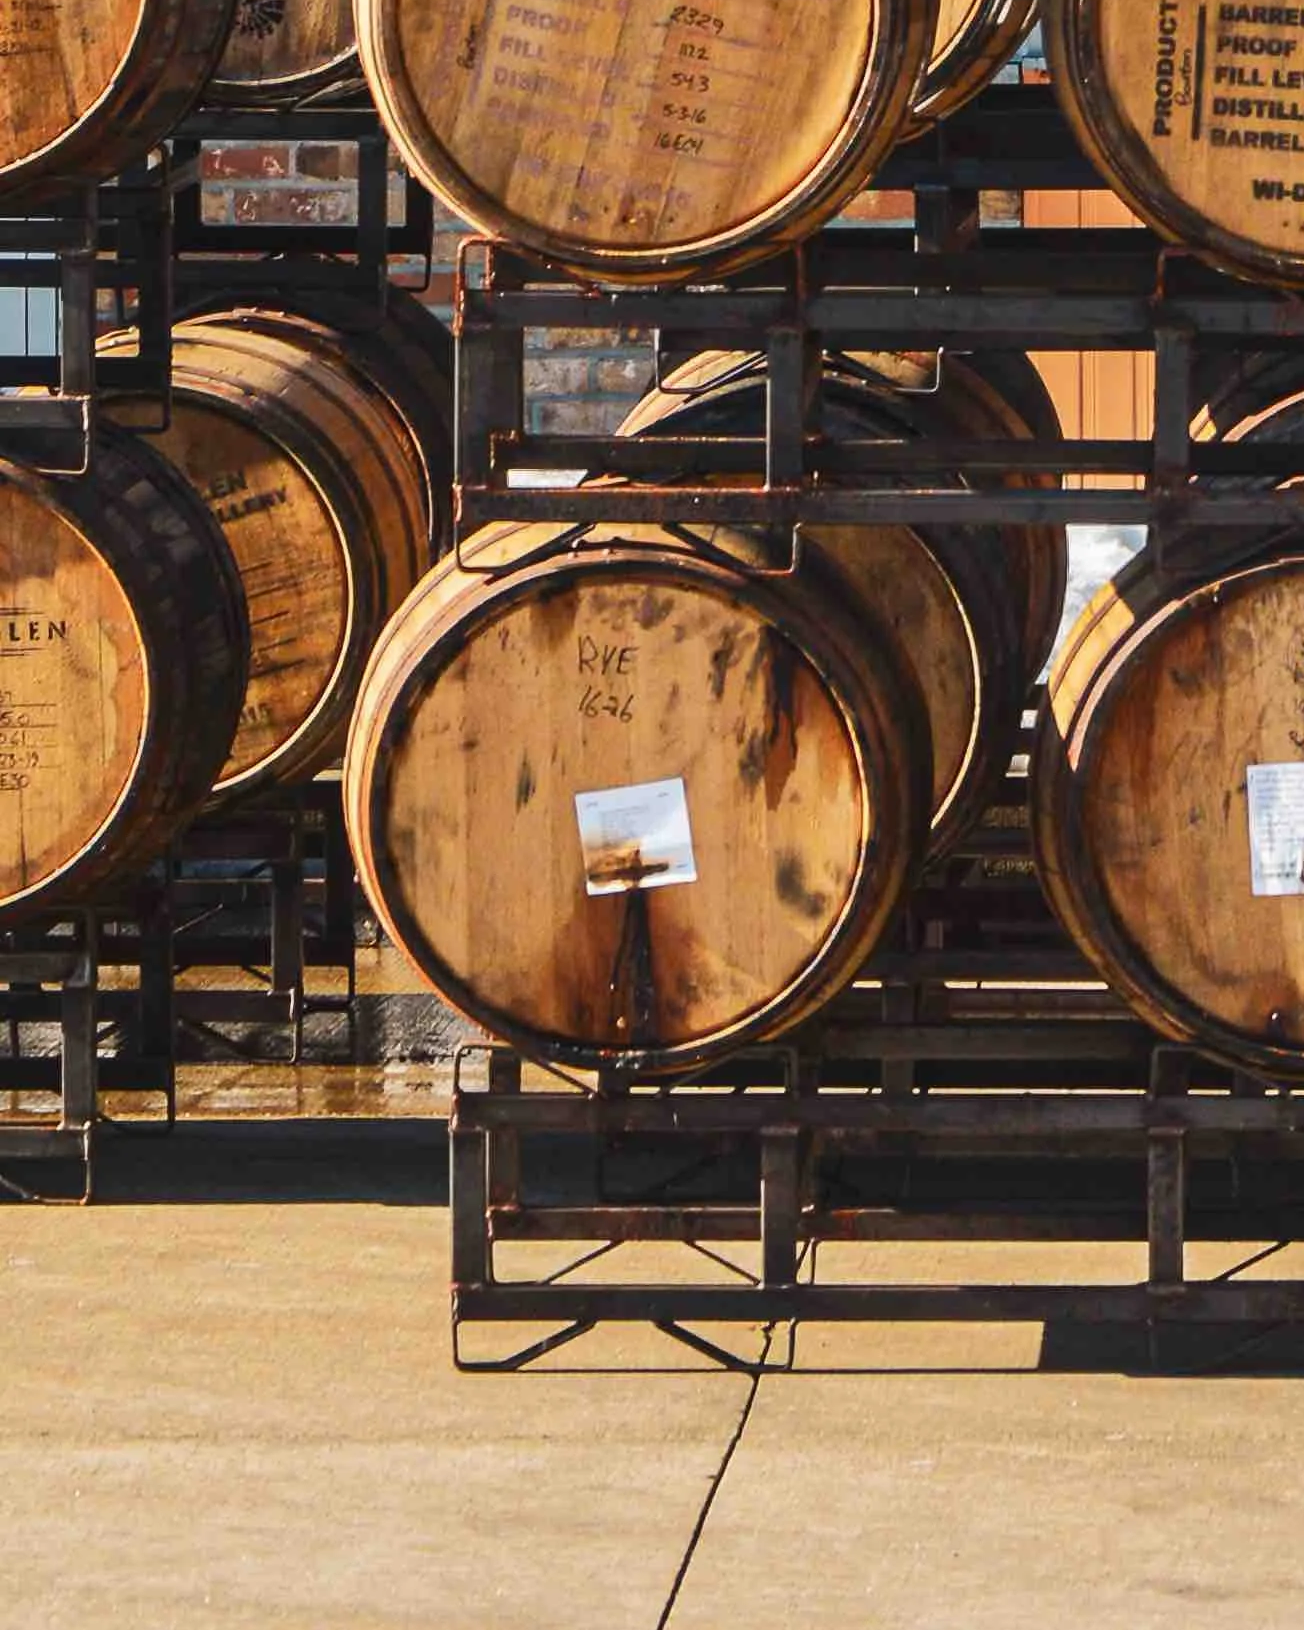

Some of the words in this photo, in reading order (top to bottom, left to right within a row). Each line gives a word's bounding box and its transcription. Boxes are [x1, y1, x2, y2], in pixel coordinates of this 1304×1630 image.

[1216, 37, 1297, 58] PROOF
[1214, 66, 1265, 87] FILL
[8, 620, 67, 641] LEN
[578, 635, 640, 676] RYE
